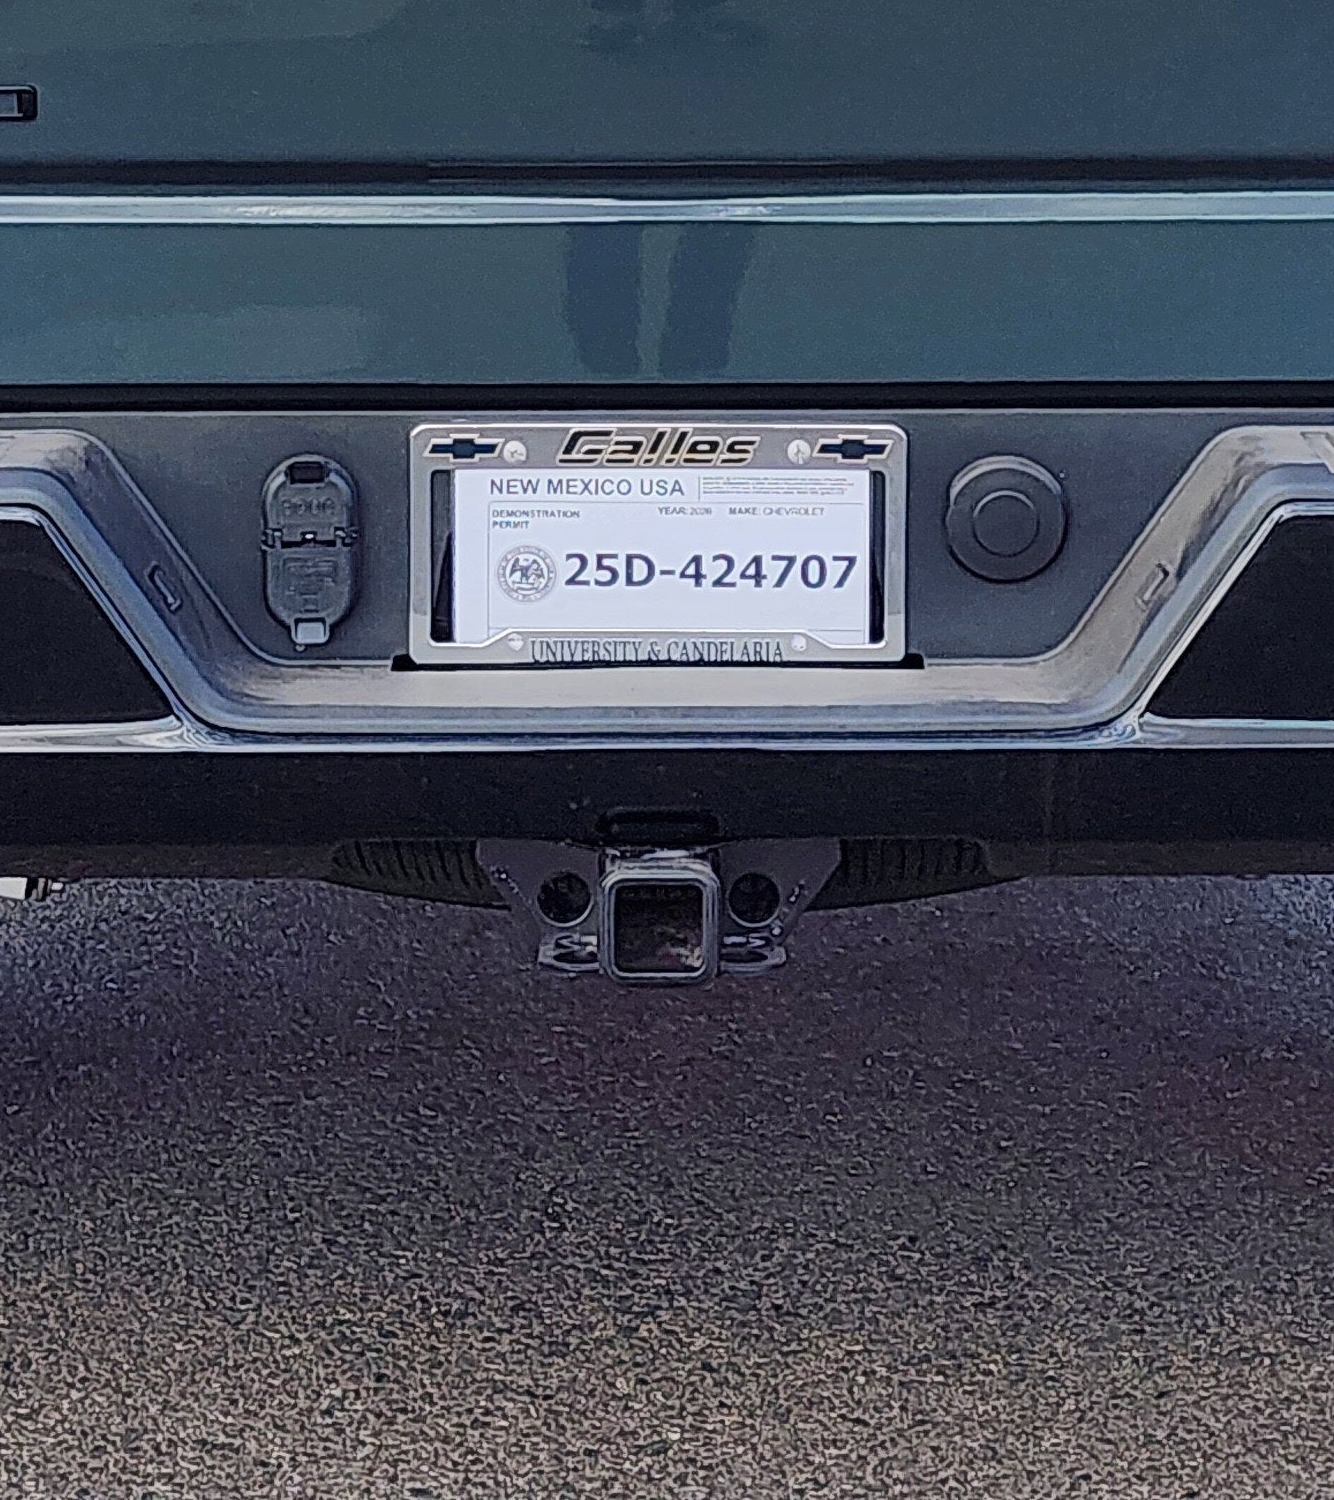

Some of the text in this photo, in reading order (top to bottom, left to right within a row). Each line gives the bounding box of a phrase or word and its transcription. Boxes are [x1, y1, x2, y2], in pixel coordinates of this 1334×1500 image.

[557, 428, 762, 467] Galles
[490, 479, 540, 495] NEW
[547, 479, 632, 496] MEXICO
[640, 479, 685, 496] USA
[492, 510, 580, 518] DEMONSTRATION
[492, 521, 530, 529] PERMIT
[564, 553, 858, 589] 25D-424707
[530, 639, 783, 662] UNIVERSITY & CANDELARIA
